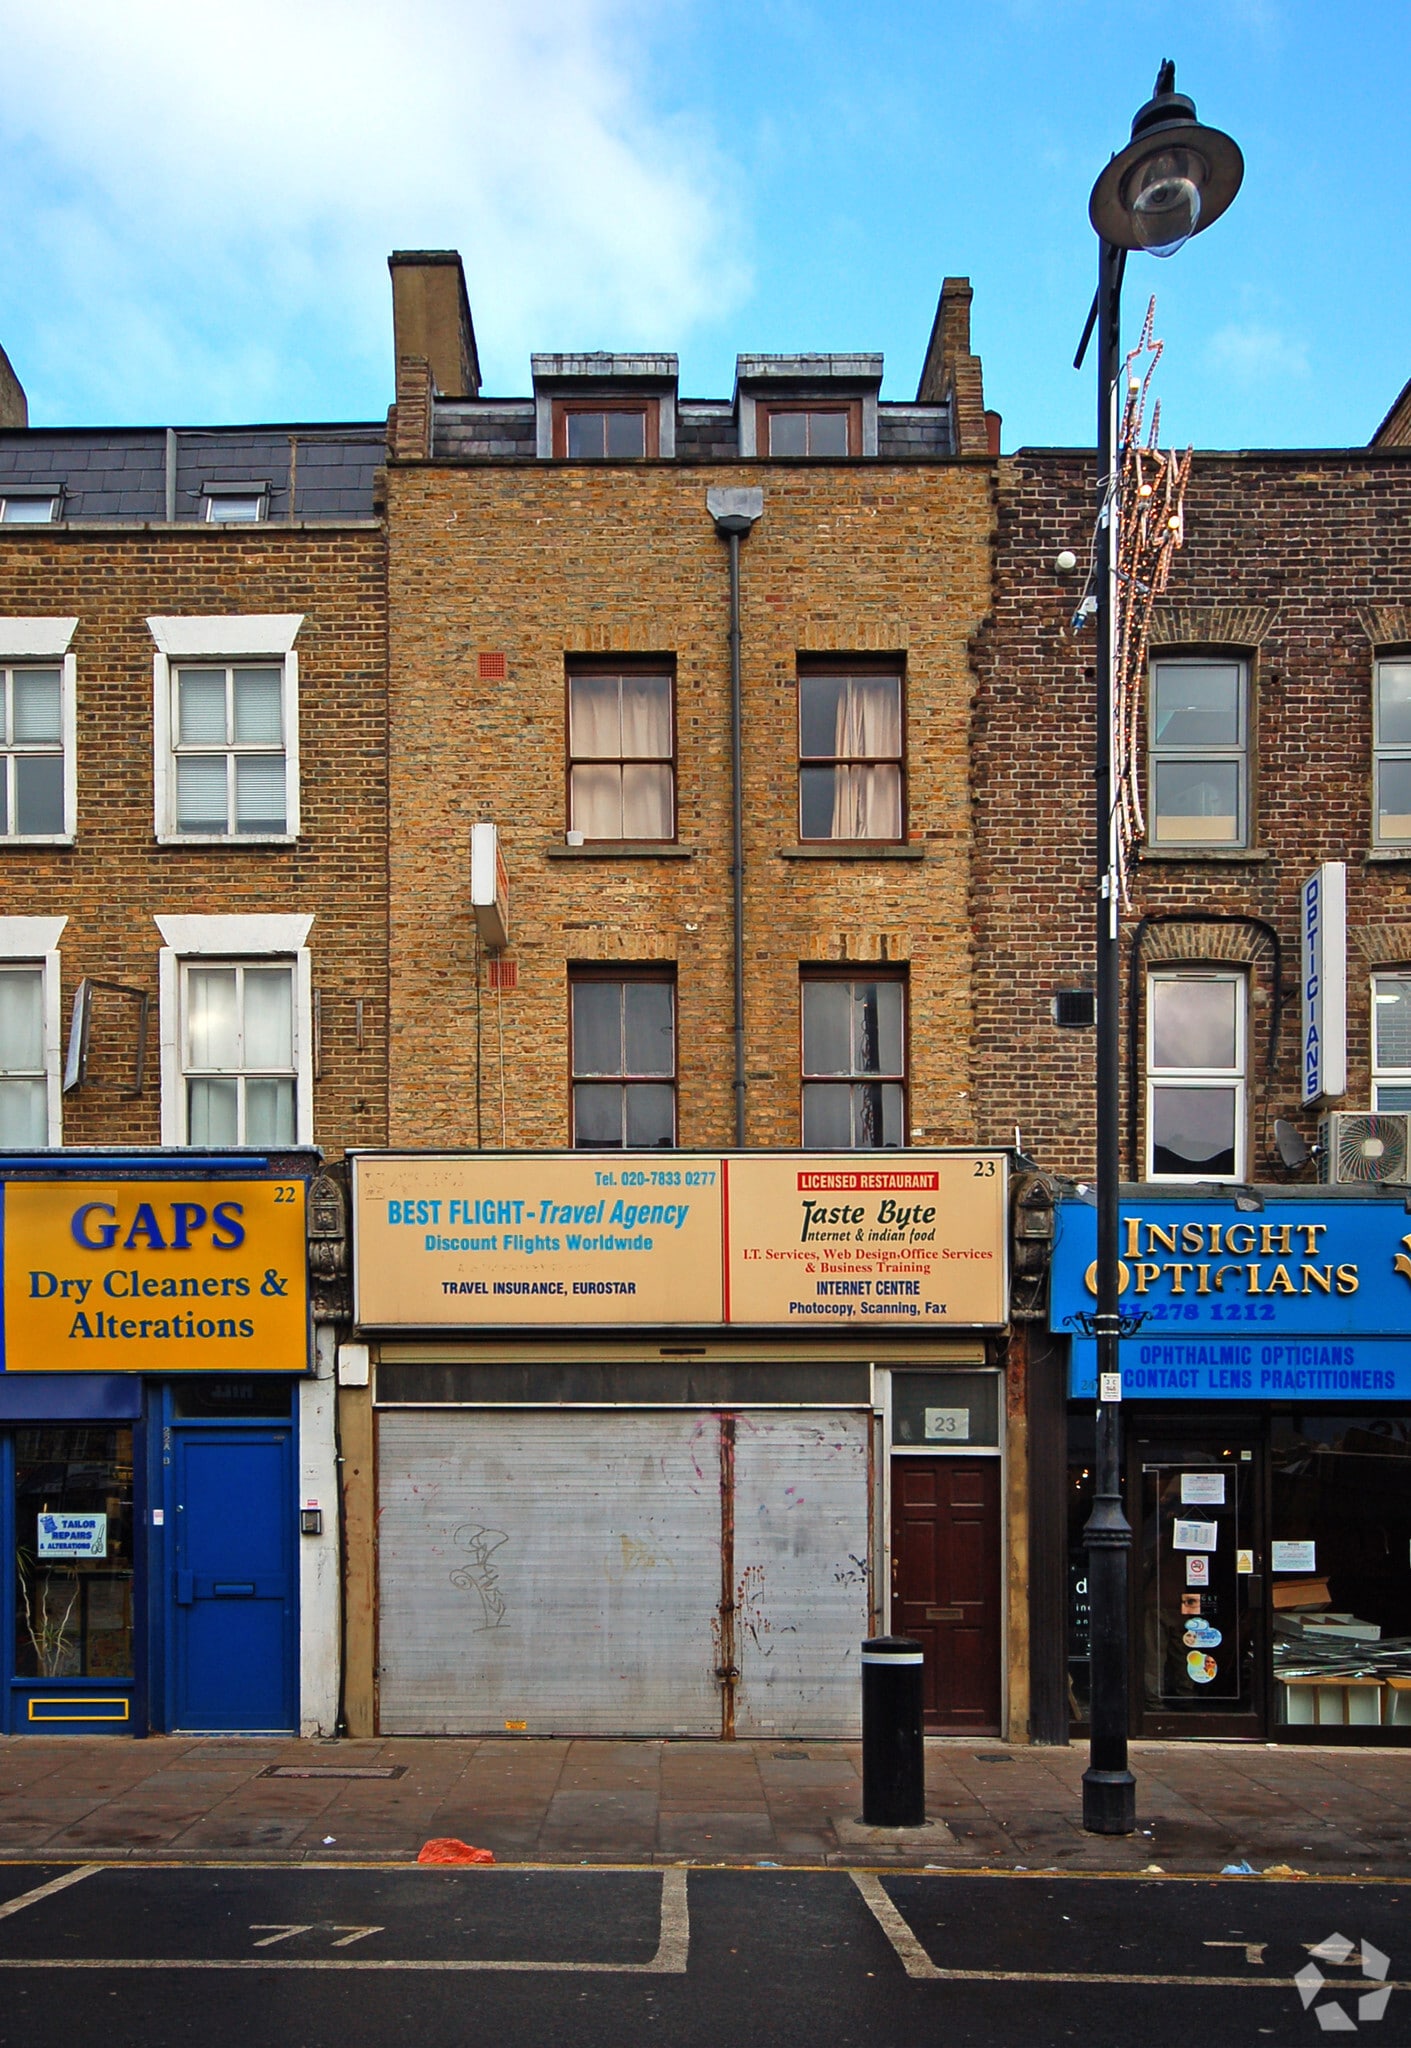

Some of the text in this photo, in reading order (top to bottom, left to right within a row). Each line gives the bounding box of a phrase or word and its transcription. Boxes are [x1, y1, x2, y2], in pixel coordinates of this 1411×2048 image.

[1306, 880, 1319, 1095] OPTICIANS
[973, 1161, 996, 1177] 23
[594, 1171, 716, 1186] Tel. 020-7833 0277
[801, 1174, 935, 1188] LICENSED RESTAURANT
[273, 1187, 296, 1203] 22
[387, 1199, 442, 1225] BEST
[608, 1199, 690, 1229] Agency
[801, 1199, 937, 1242] Taste Byte
[71, 1201, 246, 1249] GAPS
[854, 1229, 864, 1242] &
[867, 1228, 905, 1242] indian
[908, 1228, 937, 1243] food
[1123, 1217, 1328, 1258] INSIGHT
[425, 1234, 654, 1254] Discount Flights Worldwide
[743, 1249, 762, 1260] I.T.
[765, 1249, 820, 1262] Services,
[823, 1249, 852, 1260] Web
[942, 1249, 993, 1260] Services
[804, 1262, 931, 1275] & Business Training
[1084, 1258, 1360, 1296] OPTICIANS
[28, 1268, 289, 1304] Dry Cleaners &
[441, 1281, 637, 1297] TRAVEL INSURANCE, EUROSTAR
[816, 1280, 920, 1295] INTERNET CENTRE
[789, 1302, 947, 1316] Photocopy, Scanning, Fax
[1152, 1303, 1200, 1321] 278
[1210, 1303, 1276, 1321] 1212
[68, 1311, 255, 1339] Alterations
[1139, 1346, 1355, 1366] OPHTHALMIC OPTICIANS
[1122, 1369, 1396, 1390] CONTACT LENS PRACTITIONERS
[934, 1417, 957, 1433] 23
[62, 1520, 96, 1529] TAILOR
[52, 1531, 93, 1540] REPAIRS
[47, 1542, 91, 1550] ALTERATIONS
